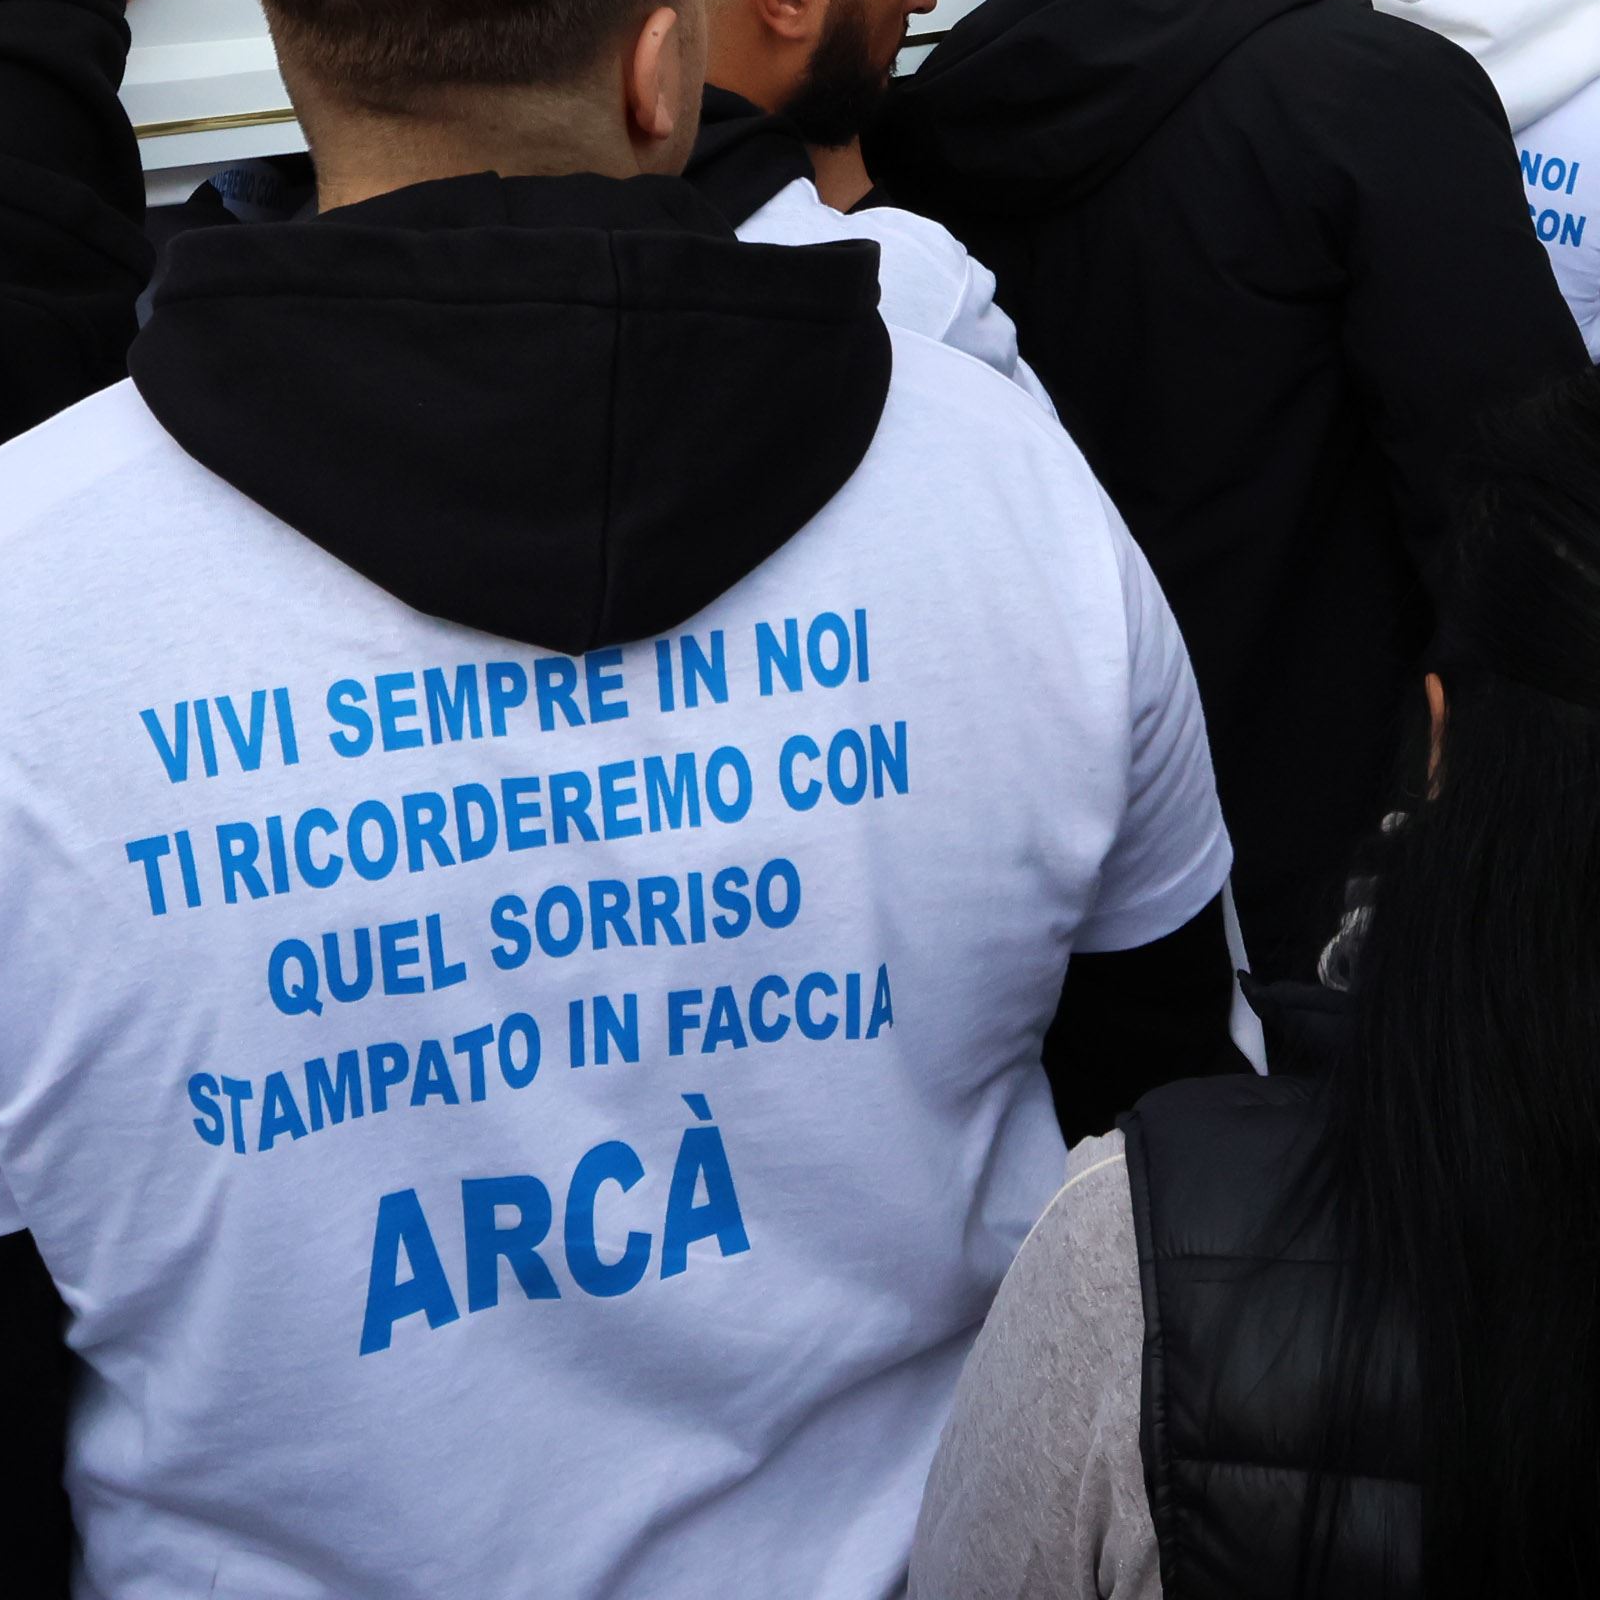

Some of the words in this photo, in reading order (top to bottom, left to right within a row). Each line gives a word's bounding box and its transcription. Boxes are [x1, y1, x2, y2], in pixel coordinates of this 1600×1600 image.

[1520, 149, 1580, 195] NOI
[1528, 203, 1587, 248] ON
[139, 688, 299, 783] VIVI
[327, 646, 630, 758] SEMPRE
[656, 630, 730, 713] IN
[755, 608, 871, 696] NOI
[125, 831, 203, 916] TI
[216, 745, 754, 904] RICORDEREMO
[779, 720, 910, 812] CON
[267, 914, 467, 1017] QUEL
[490, 857, 802, 970] SORRISO
[187, 1011, 542, 1155] STAMPATO
[569, 994, 641, 1069] IN
[667, 962, 895, 1057] FACCIA
[359, 1092, 752, 1357] ARCÀ
